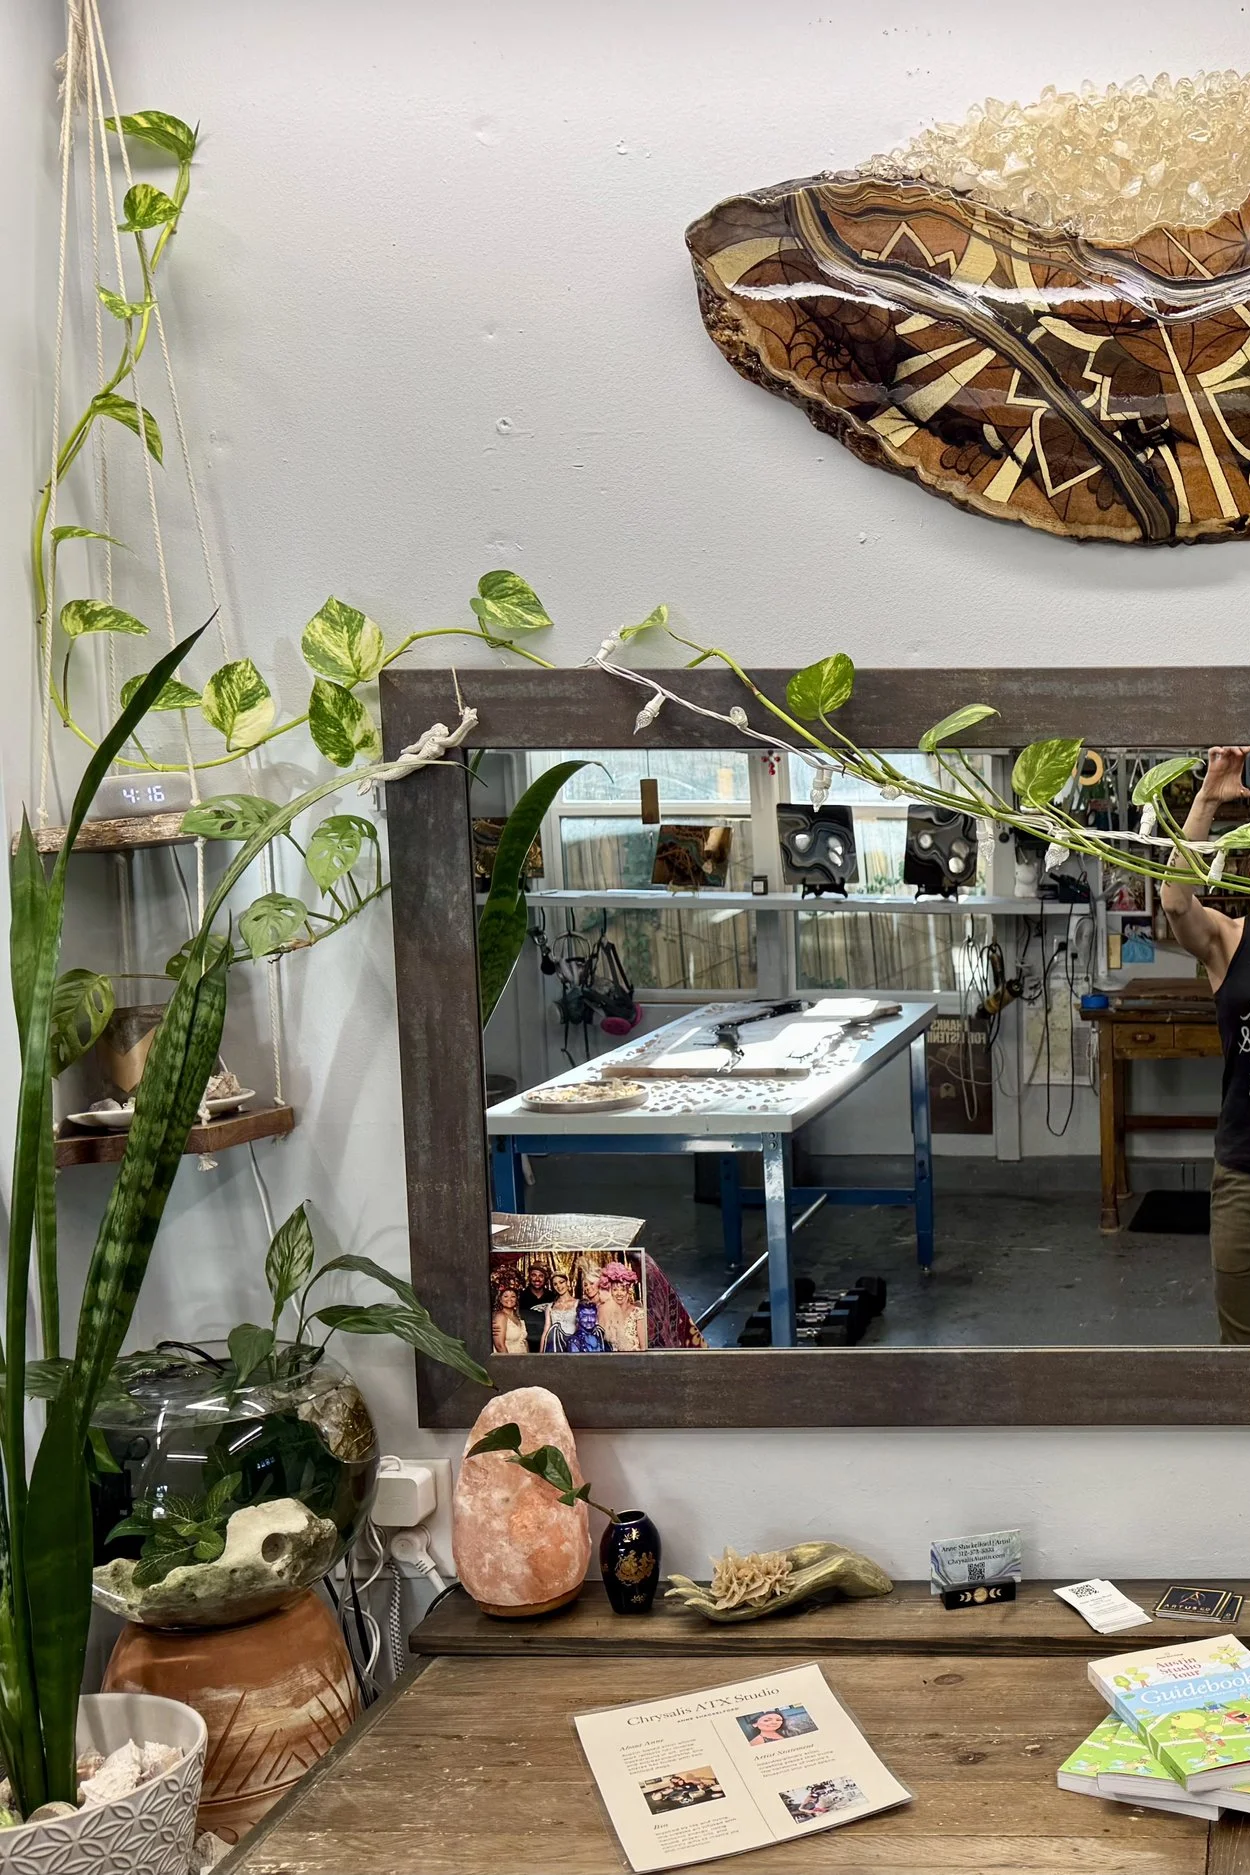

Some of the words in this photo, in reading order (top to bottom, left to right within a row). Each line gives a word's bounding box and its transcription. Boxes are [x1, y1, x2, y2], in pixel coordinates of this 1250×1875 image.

[122, 785, 165, 804] 4:16
[1156, 1657, 1197, 1669] Austin
[1159, 1663, 1202, 1675] Studio
[1169, 1670, 1200, 1679] Tour
[627, 1706, 692, 1726] Chrysalis
[695, 1698, 733, 1712] ATX
[734, 1688, 780, 1703] Studio
